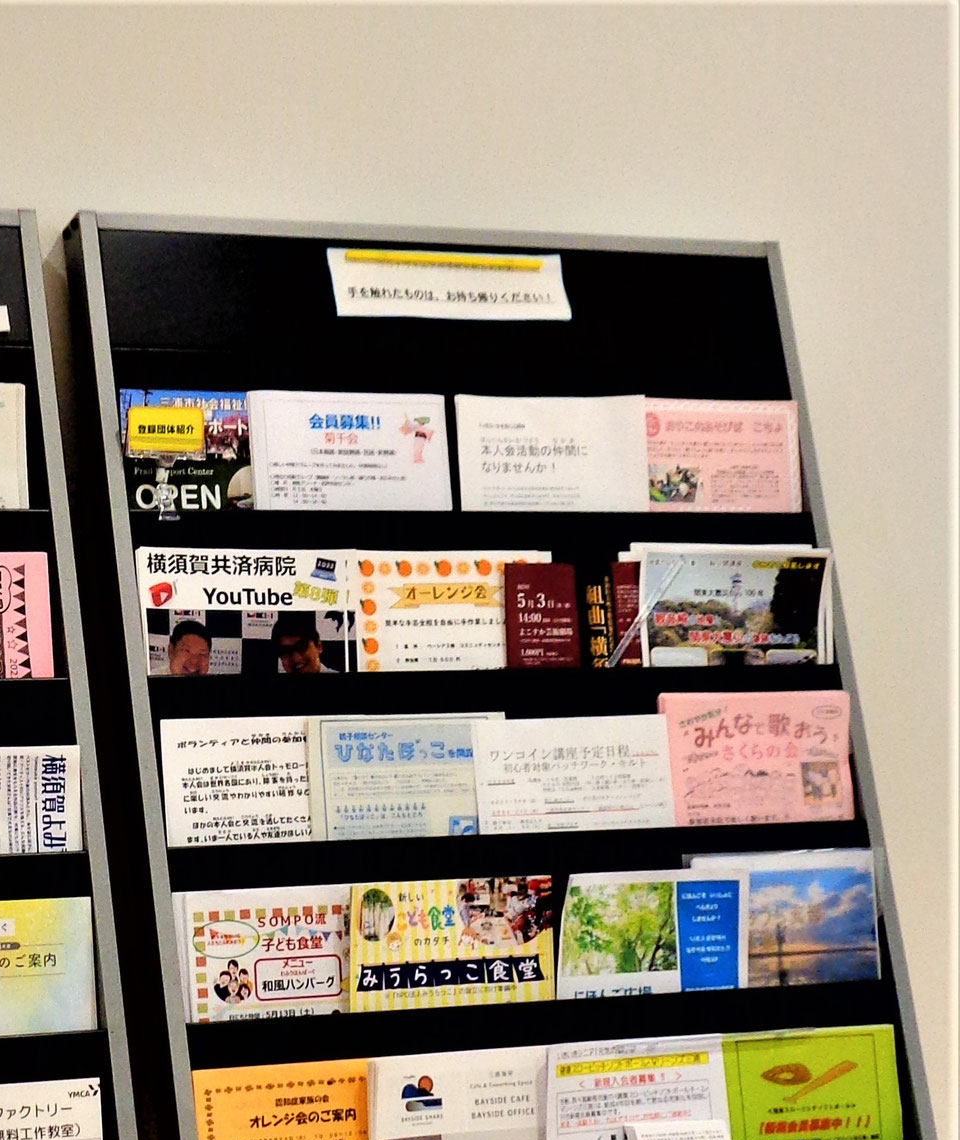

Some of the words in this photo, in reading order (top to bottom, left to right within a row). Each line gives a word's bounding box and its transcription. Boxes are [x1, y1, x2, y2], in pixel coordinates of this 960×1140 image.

[160, 397, 248, 411] 三浦市社会福祉
[138, 424, 195, 435] 登録団体紹介
[481, 444, 589, 457] 本人会活動の仲間に
[187, 466, 215, 476] Center
[146, 552, 297, 577] 横須賀共済病院
[202, 587, 293, 606] YouTube
[517, 592, 555, 608] 5月3日
[519, 612, 542, 623] 14:00
[490, 744, 630, 762] ワンコイン講座予定日程
[723, 742, 799, 761] さくらの会
[182, 774, 310, 790] 本人会は世界各国にあり、障害を持った
[41, 754, 68, 851] 横須賀よみ
[398, 891, 425, 903] 新しい
[258, 912, 327, 928] SOMPO流
[397, 904, 455, 931] こども食堂
[261, 936, 323, 952] 子ども食堂
[414, 936, 450, 946] のカタチ
[282, 959, 313, 969] メニュー
[362, 958, 539, 987] みうらっこ食堂
[262, 975, 335, 993] 和風ハンバーグ
[67, 1089, 91, 1099] YMCA
[474, 1095, 508, 1106] BAYSIDE
[510, 1094, 530, 1103] CAFE
[249, 1108, 357, 1128] オレンジ会のご案内
[401, 1115, 423, 1123] BAYSIDE
[471, 1109, 504, 1119] BAYSIDE
[507, 1108, 535, 1117] OFFICE
